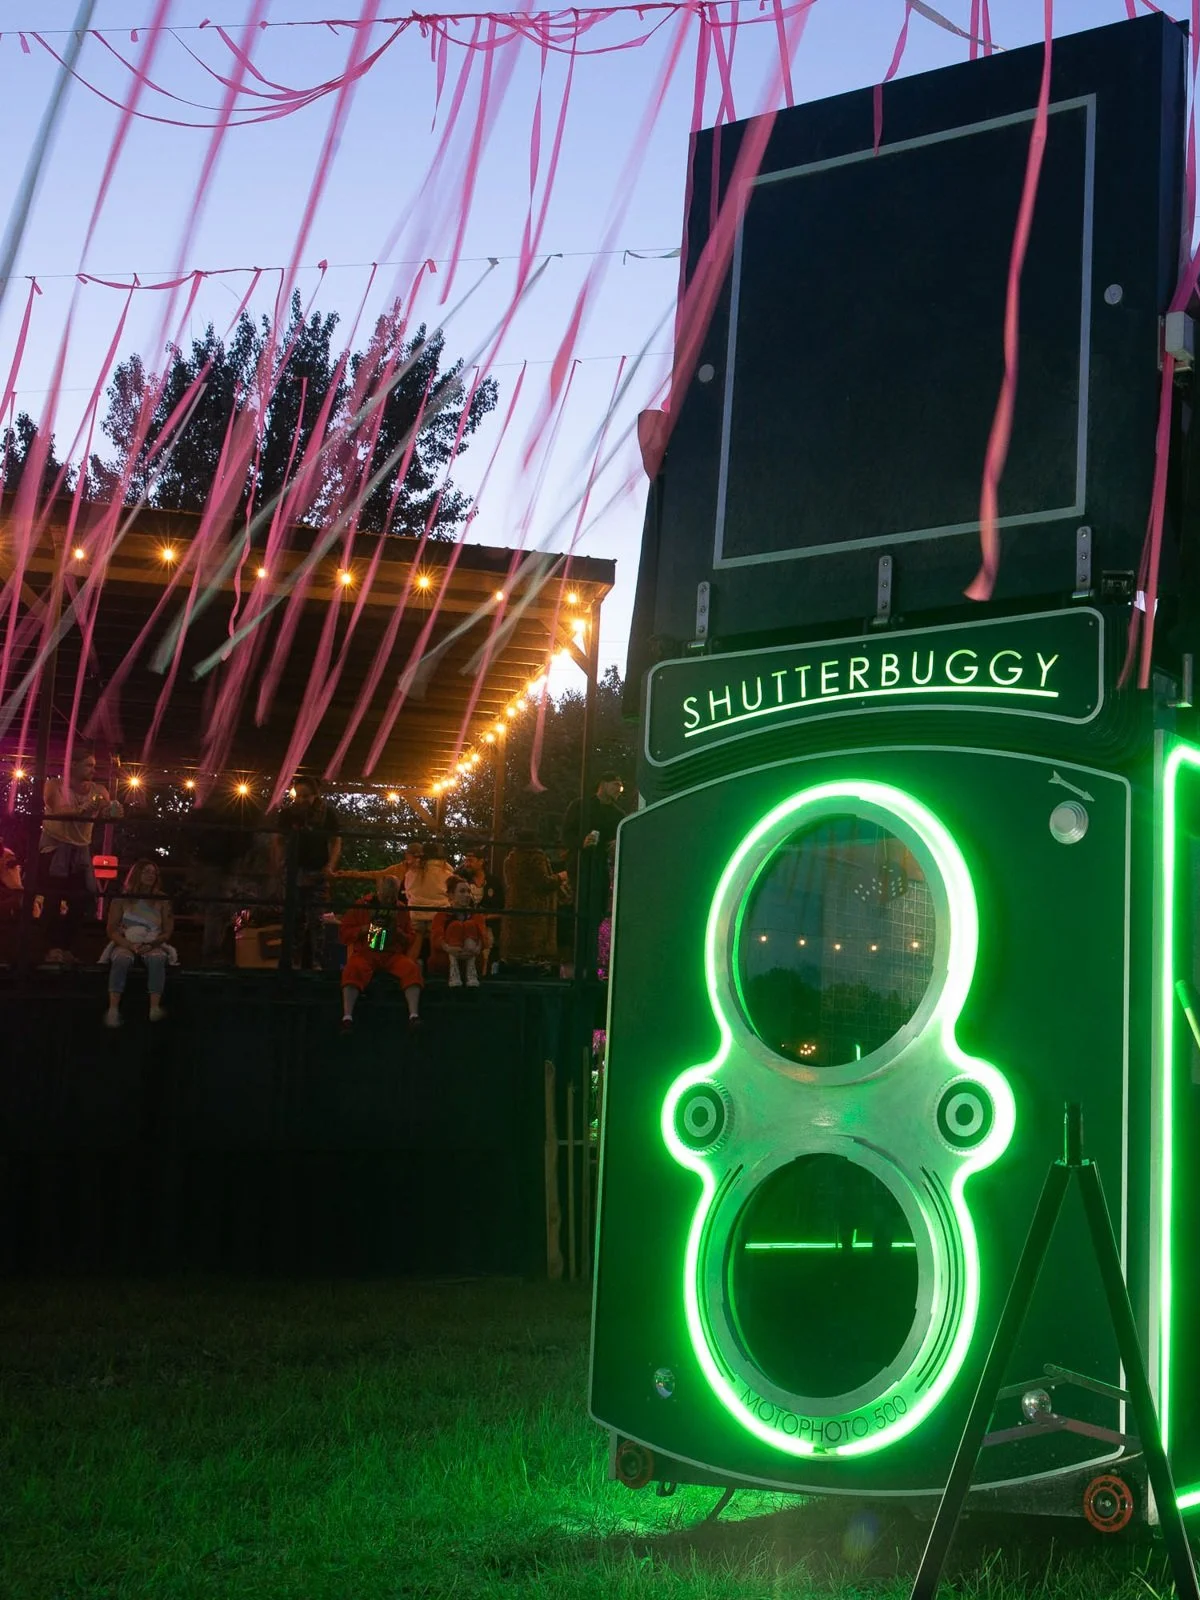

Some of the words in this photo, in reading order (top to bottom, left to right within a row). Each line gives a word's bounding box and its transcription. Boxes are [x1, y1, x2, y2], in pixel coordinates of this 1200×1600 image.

[682, 648, 1060, 729] SHUTTERBUGGY
[740, 1387, 870, 1443] MOTOPHOTO
[872, 1395, 908, 1430] 500
